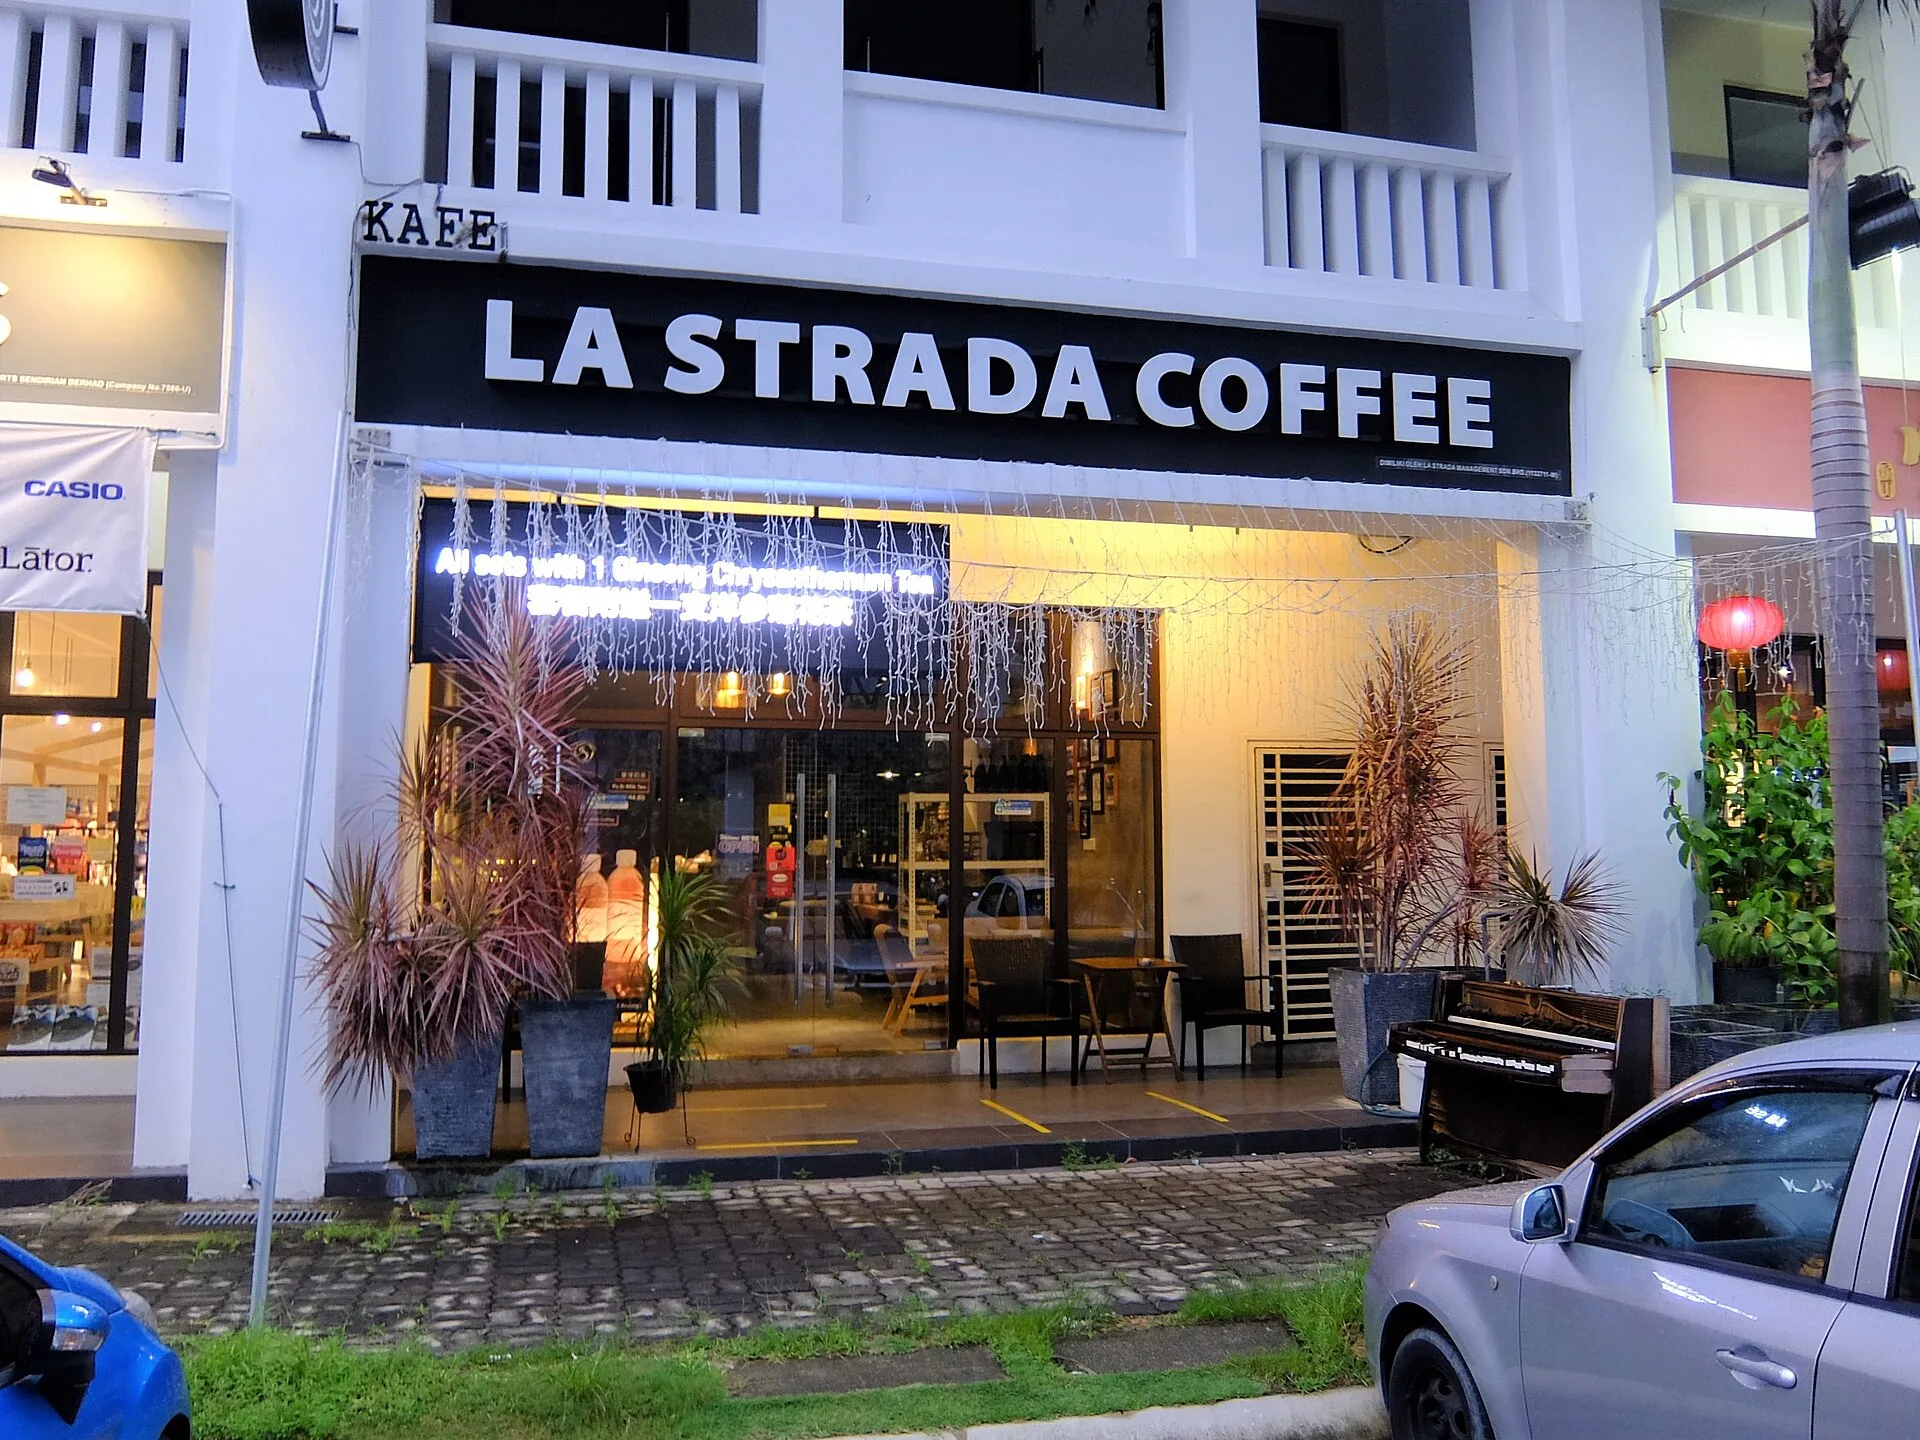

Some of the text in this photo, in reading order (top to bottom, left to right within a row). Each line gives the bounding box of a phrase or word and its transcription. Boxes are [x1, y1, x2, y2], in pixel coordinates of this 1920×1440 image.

[363, 200, 496, 251] KAFE
[19, 375, 67, 386] SENDIRIAN
[67, 377, 105, 388] BERHAD
[105, 380, 147, 393] (Company
[485, 299, 1494, 449] LA STRADA COFFEE
[1432, 463, 1456, 471] STRADA
[24, 480, 123, 500] CASIO
[435, 547, 470, 575] All
[474, 551, 527, 577] sets
[532, 553, 586, 580] with
[591, 555, 605, 580] 1
[896, 569, 935, 595] Tea
